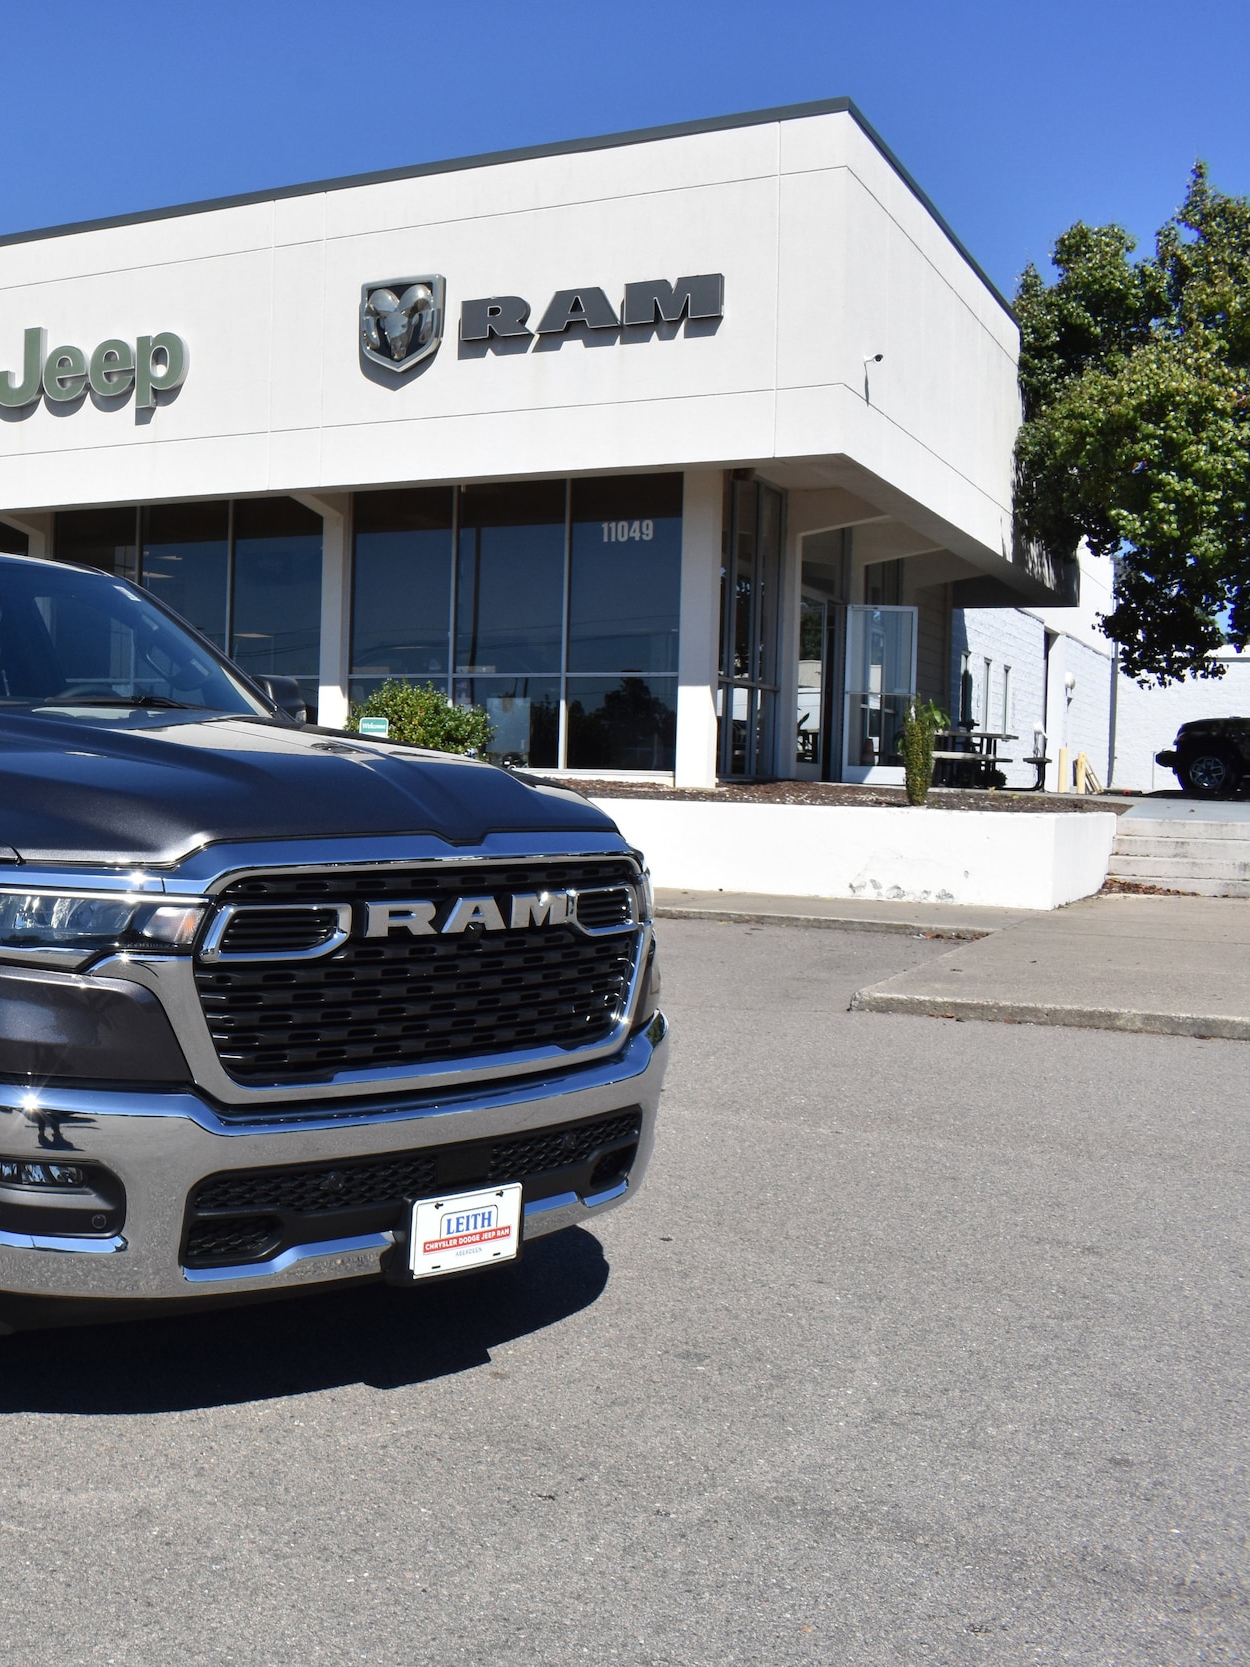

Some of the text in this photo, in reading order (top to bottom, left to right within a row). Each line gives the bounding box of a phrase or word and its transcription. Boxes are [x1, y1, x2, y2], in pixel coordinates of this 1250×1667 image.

[459, 273, 725, 341] RAM
[601, 519, 654, 542] 11049
[365, 890, 568, 937] RAM
[446, 1210, 493, 1235] LEITH
[424, 1227, 510, 1250] CHRYSLER DODGE JEEP RAM
